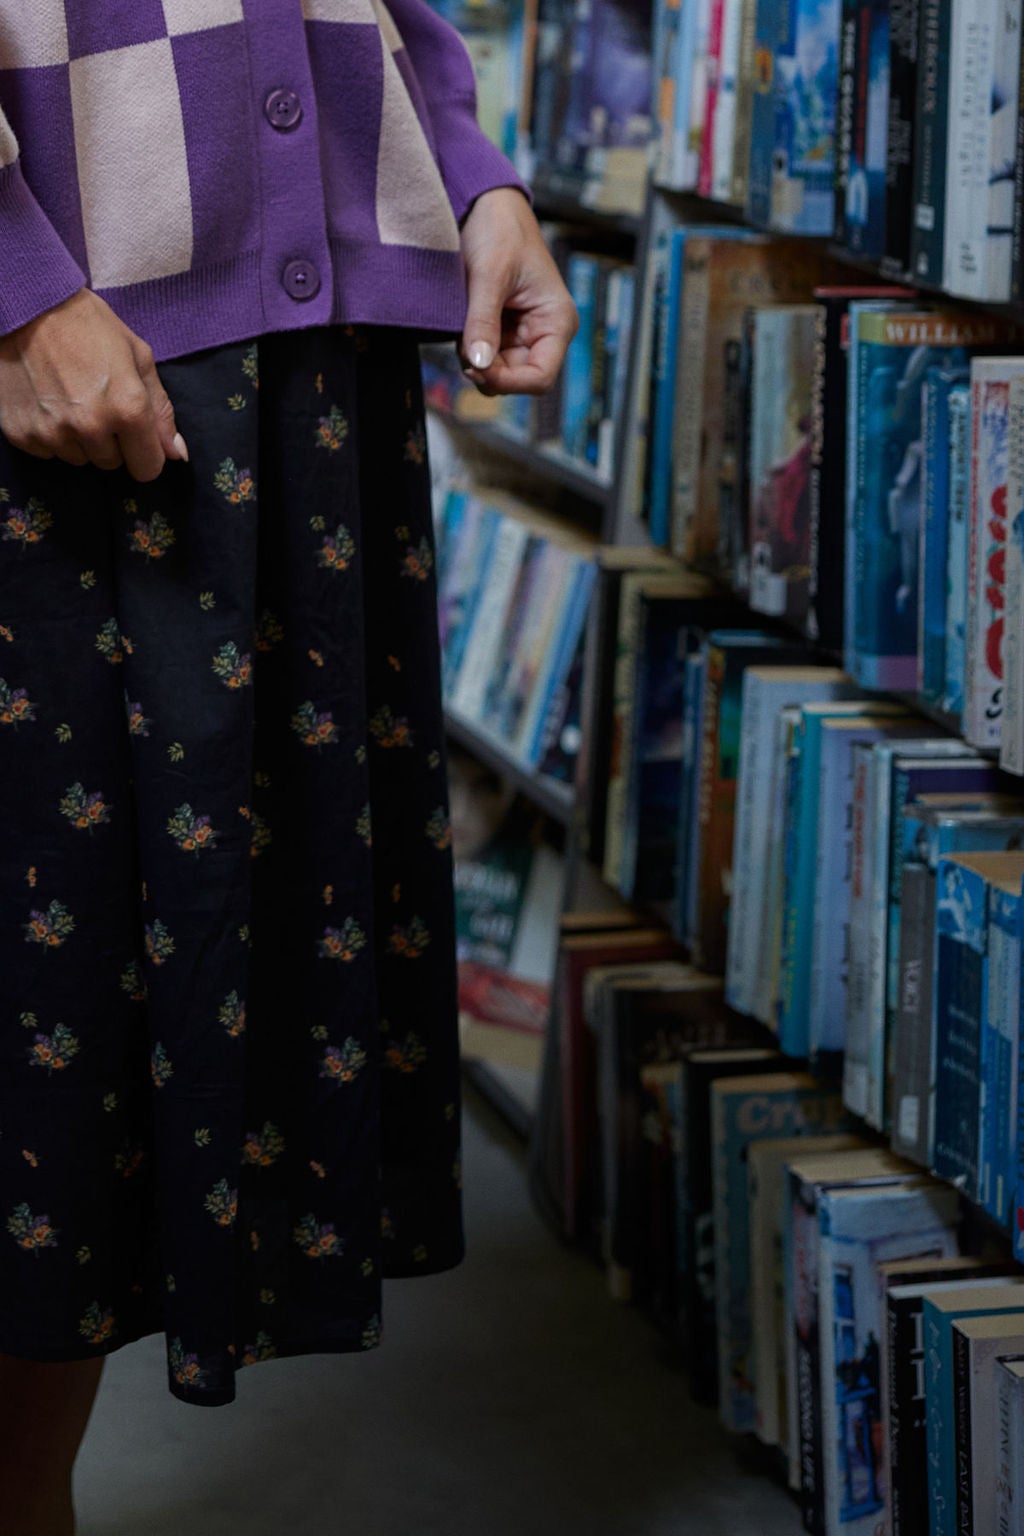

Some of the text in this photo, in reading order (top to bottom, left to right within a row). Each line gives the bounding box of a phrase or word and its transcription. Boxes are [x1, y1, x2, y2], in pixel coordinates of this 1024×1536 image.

[798, 1348, 814, 1441] SECOND
[800, 1442, 816, 1494] LIFE
[957, 1450, 970, 1499] LAST
